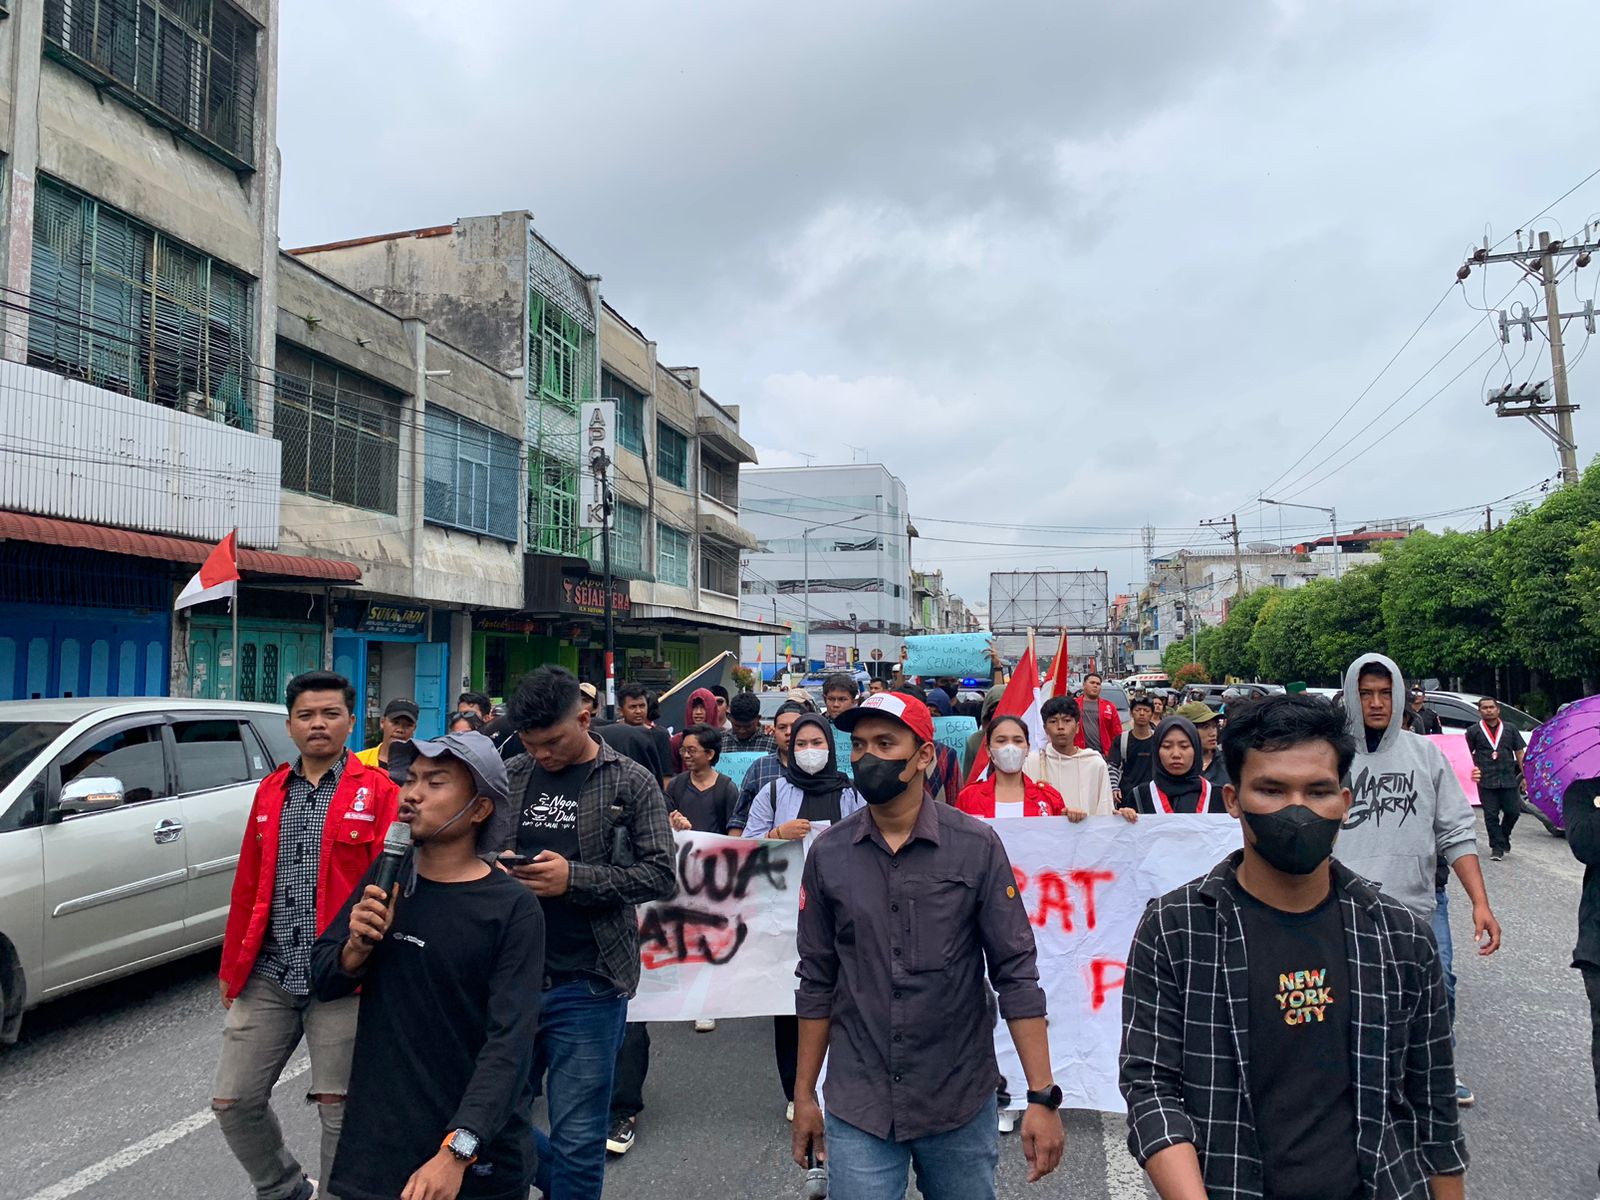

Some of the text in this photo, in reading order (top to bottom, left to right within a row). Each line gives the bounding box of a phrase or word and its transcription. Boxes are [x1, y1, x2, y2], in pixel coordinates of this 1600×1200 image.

[575, 585, 630, 610] SEJAHERA
[1341, 766, 1415, 800] MARTIN
[555, 810, 576, 822] Dulu
[1279, 968, 1326, 992] NEW
[1275, 987, 1333, 1010] YORK
[1284, 1006, 1326, 1025] CITY
